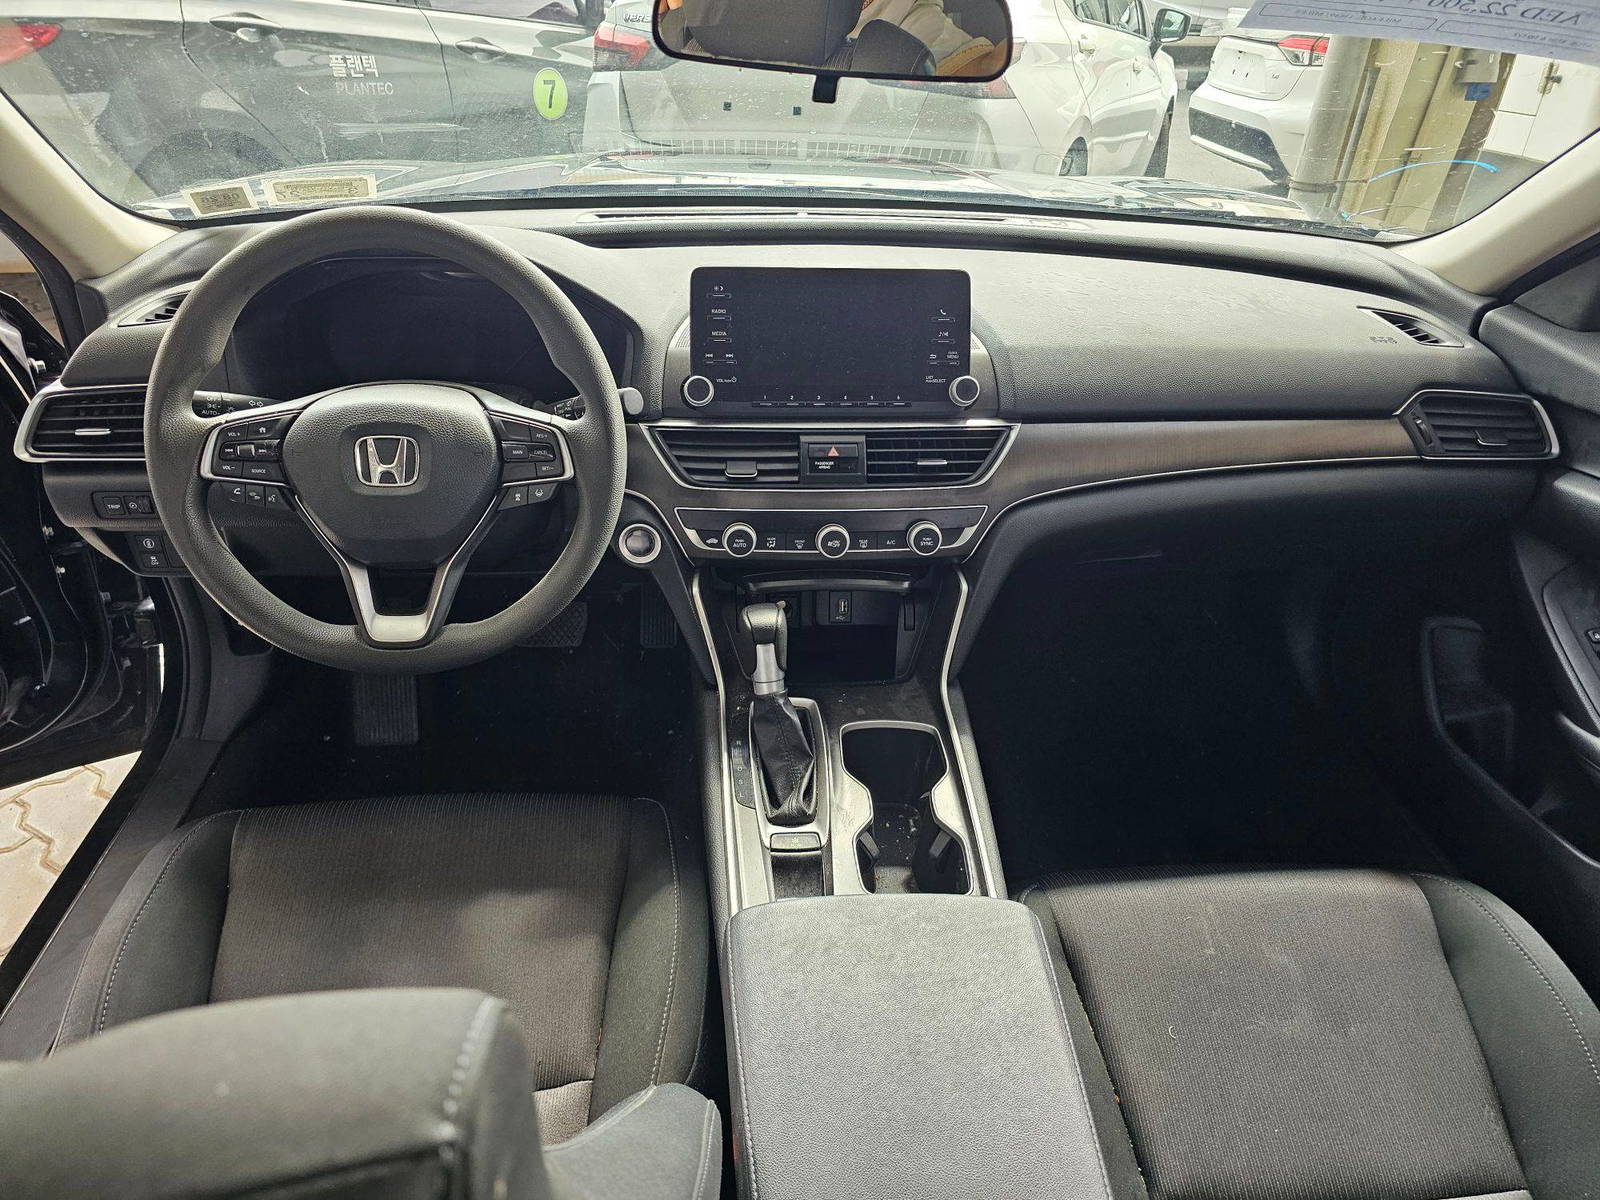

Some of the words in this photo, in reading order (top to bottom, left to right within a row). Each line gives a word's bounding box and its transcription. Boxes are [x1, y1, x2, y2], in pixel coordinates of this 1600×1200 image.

[623, 13, 651, 23] VERS
[328, 54, 379, 78] 플랜텍
[336, 81, 394, 96] PLANTEC
[543, 79, 556, 109] 7
